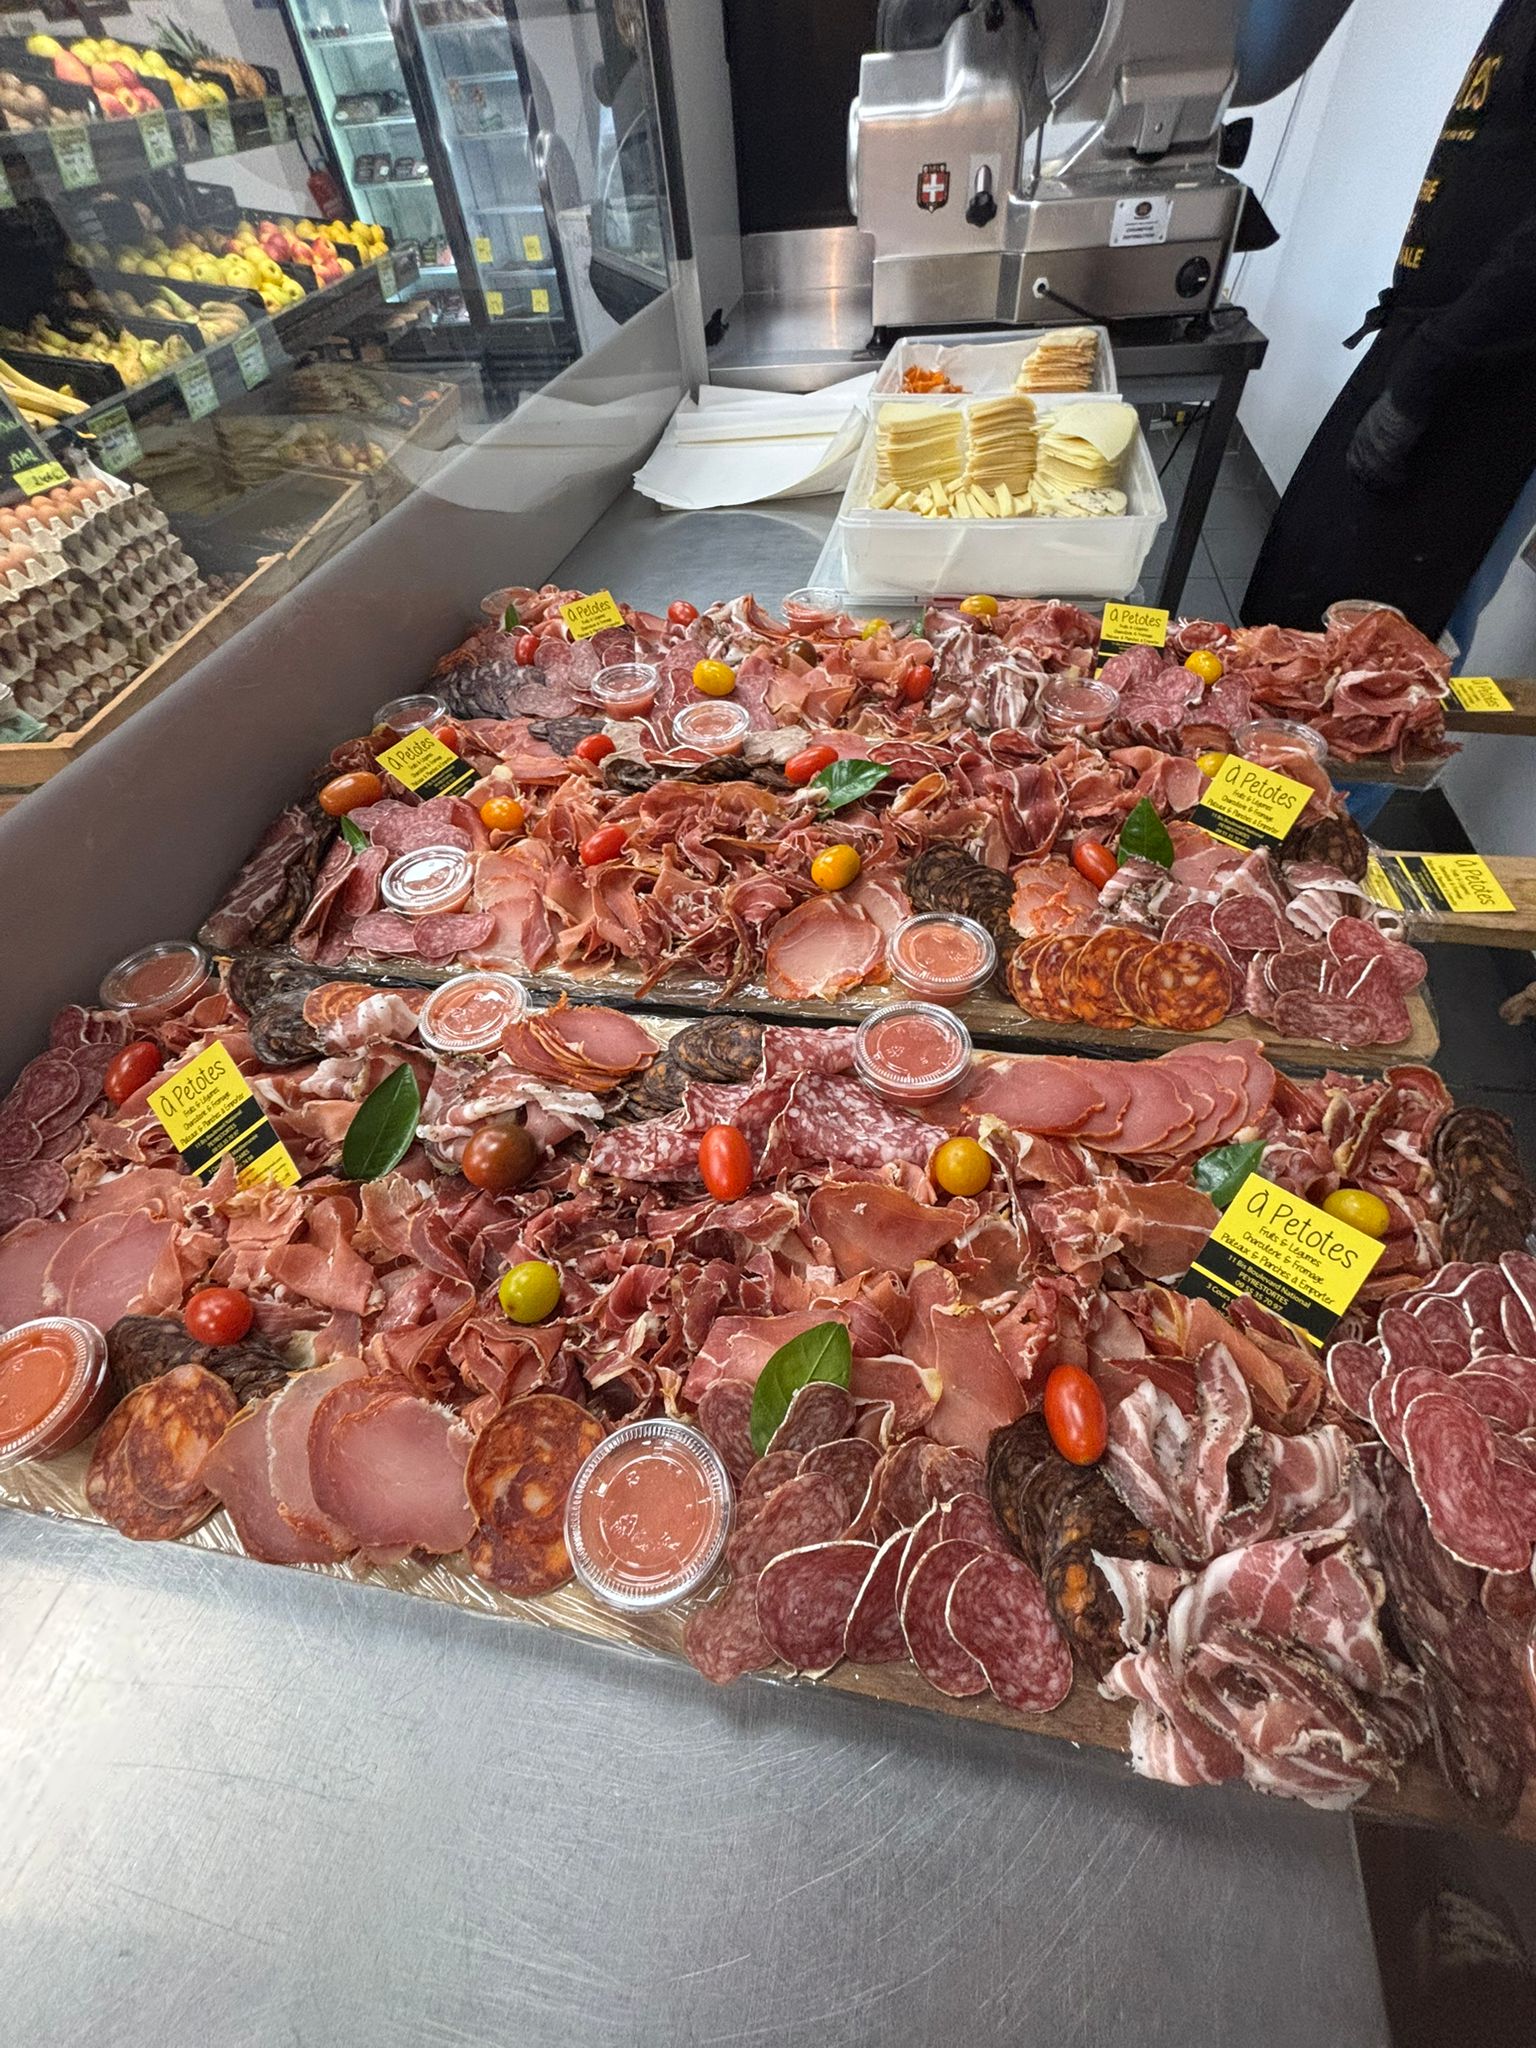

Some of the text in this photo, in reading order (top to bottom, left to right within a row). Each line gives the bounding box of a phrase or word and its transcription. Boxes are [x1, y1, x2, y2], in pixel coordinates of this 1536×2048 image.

[1225, 765, 1296, 809] À Petotes
[160, 1061, 225, 1117] À Petotes
[1247, 1190, 1357, 1268] À Petotes
[1259, 1226, 1279, 1242] Fruits
[1288, 1243, 1321, 1267] Légumes
